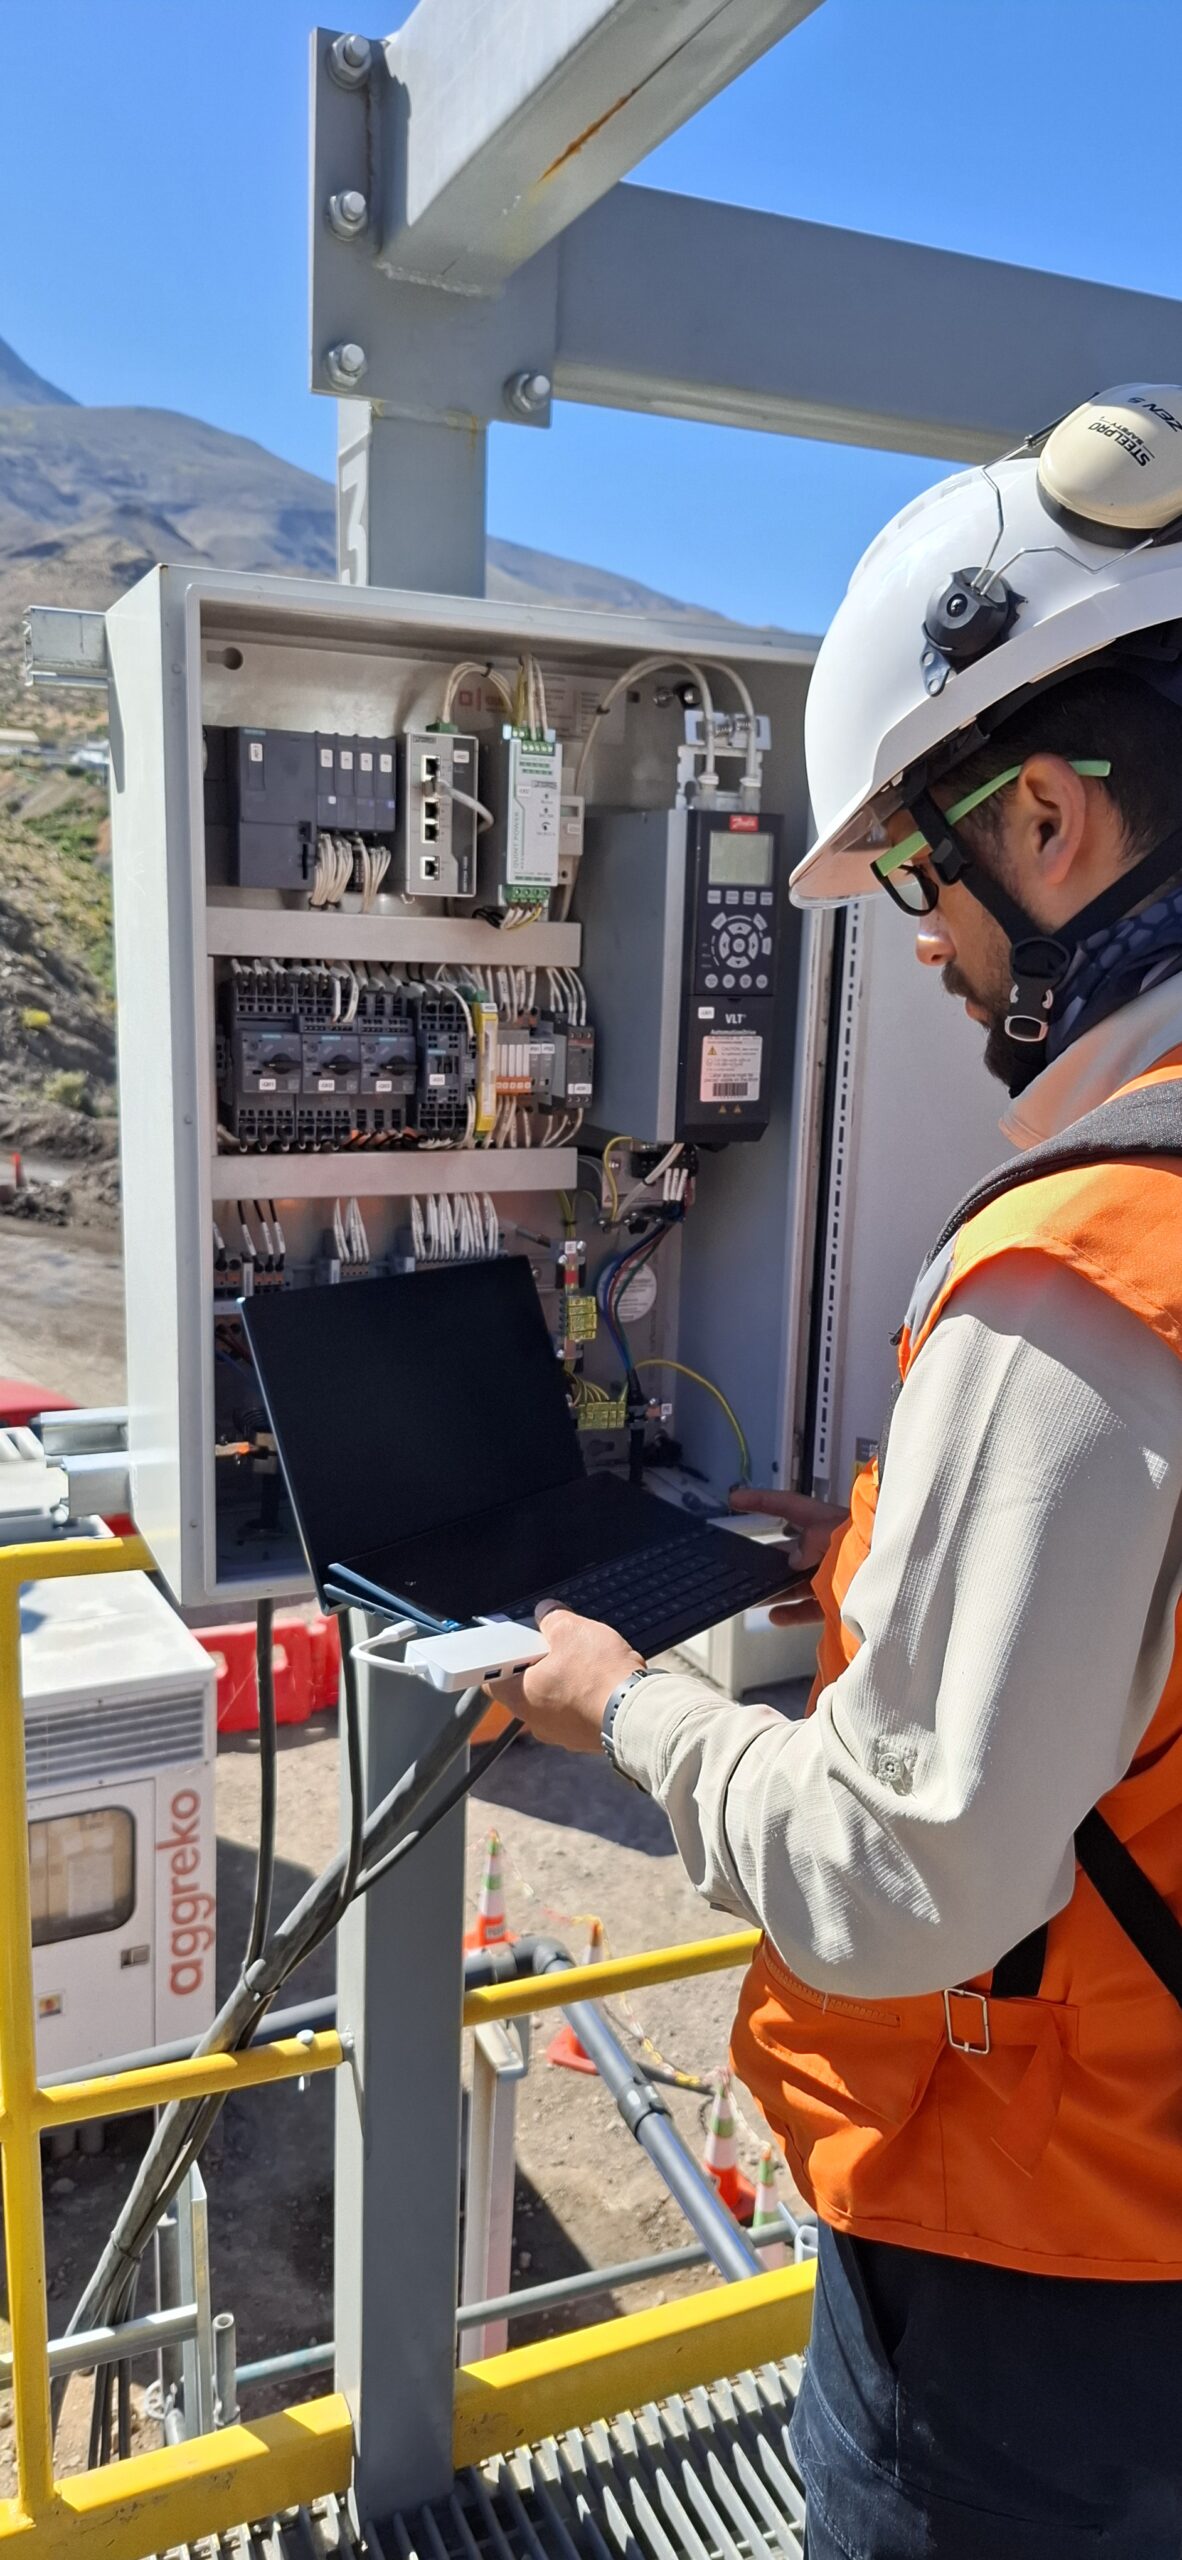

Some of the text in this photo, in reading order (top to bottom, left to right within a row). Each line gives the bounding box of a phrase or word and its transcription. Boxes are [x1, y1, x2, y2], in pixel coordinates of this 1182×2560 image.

[1110, 422, 1145, 446] SAFETY
[1142, 403, 1182, 433] ZEN
[1088, 422, 1151, 467] STEELPRO
[154, 1788, 216, 1995] aggreko
